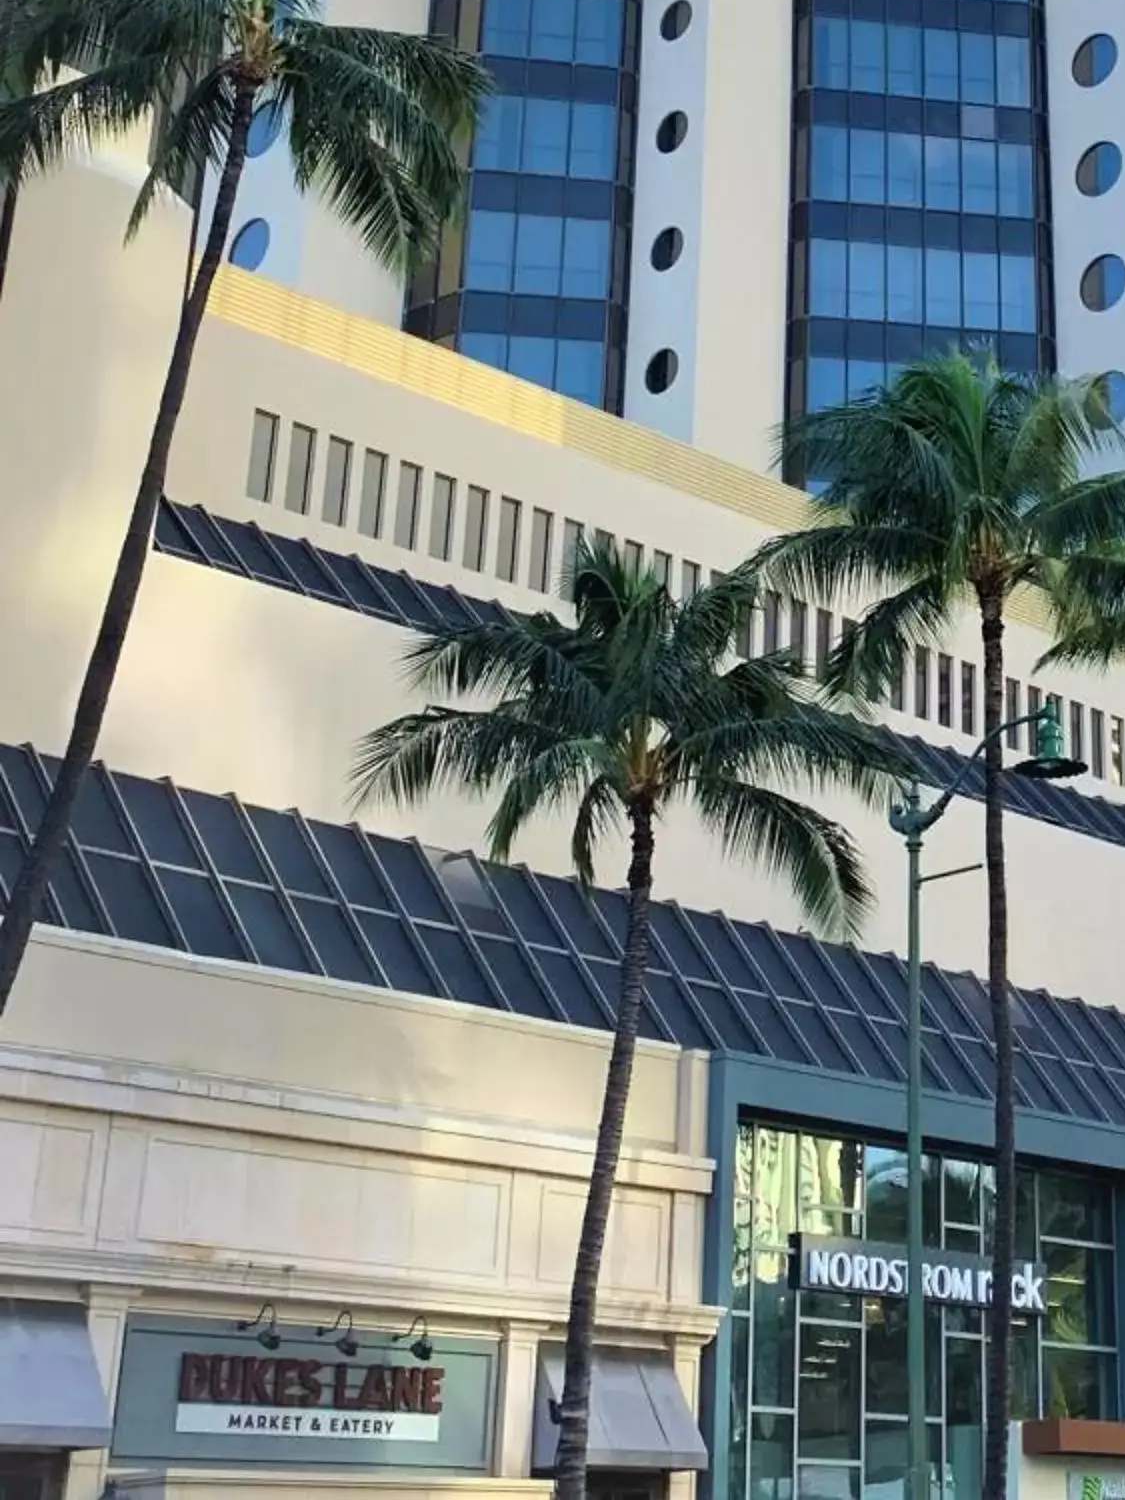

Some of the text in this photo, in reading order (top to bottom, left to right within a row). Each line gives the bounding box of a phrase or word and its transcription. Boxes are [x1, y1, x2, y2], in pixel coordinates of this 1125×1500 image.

[977, 1263, 1044, 1310] rck
[178, 1352, 445, 1414] DUKES LANE
[227, 1414, 395, 1434] MARKET & EATERY
